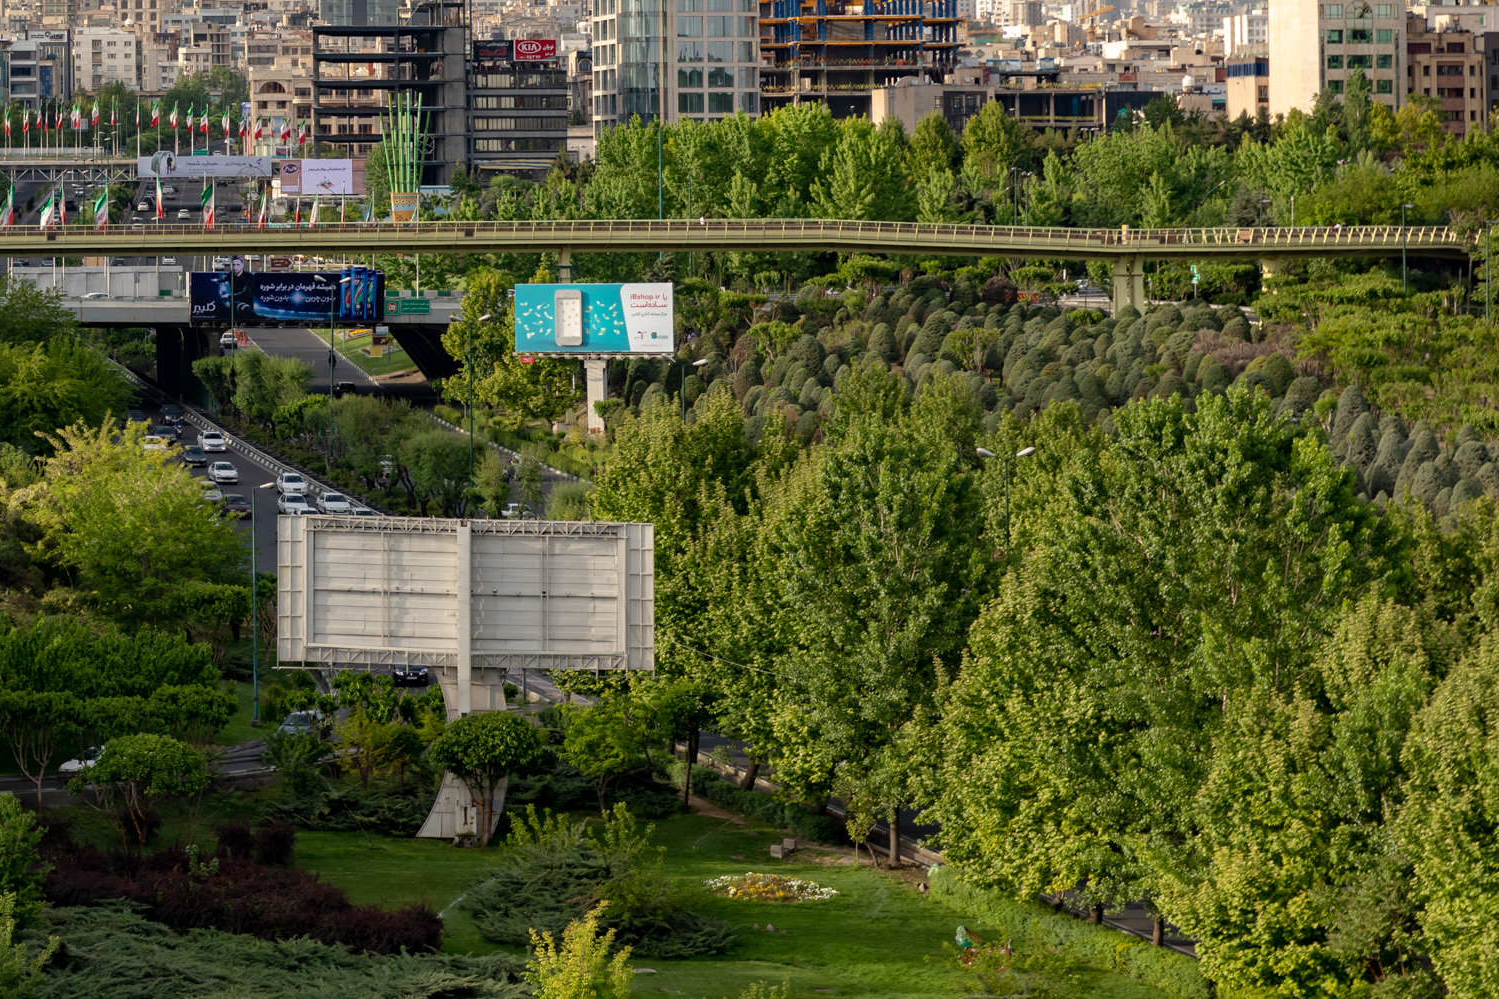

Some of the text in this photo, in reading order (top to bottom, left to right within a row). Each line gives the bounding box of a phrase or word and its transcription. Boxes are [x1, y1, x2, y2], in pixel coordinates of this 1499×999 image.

[521, 43, 538, 51] KIA
[259, 282, 337, 292] همیشه قهرمان در برابر شوره
[260, 294, 274, 303] شوره
[630, 293, 668, 302] با iBshop.ir
